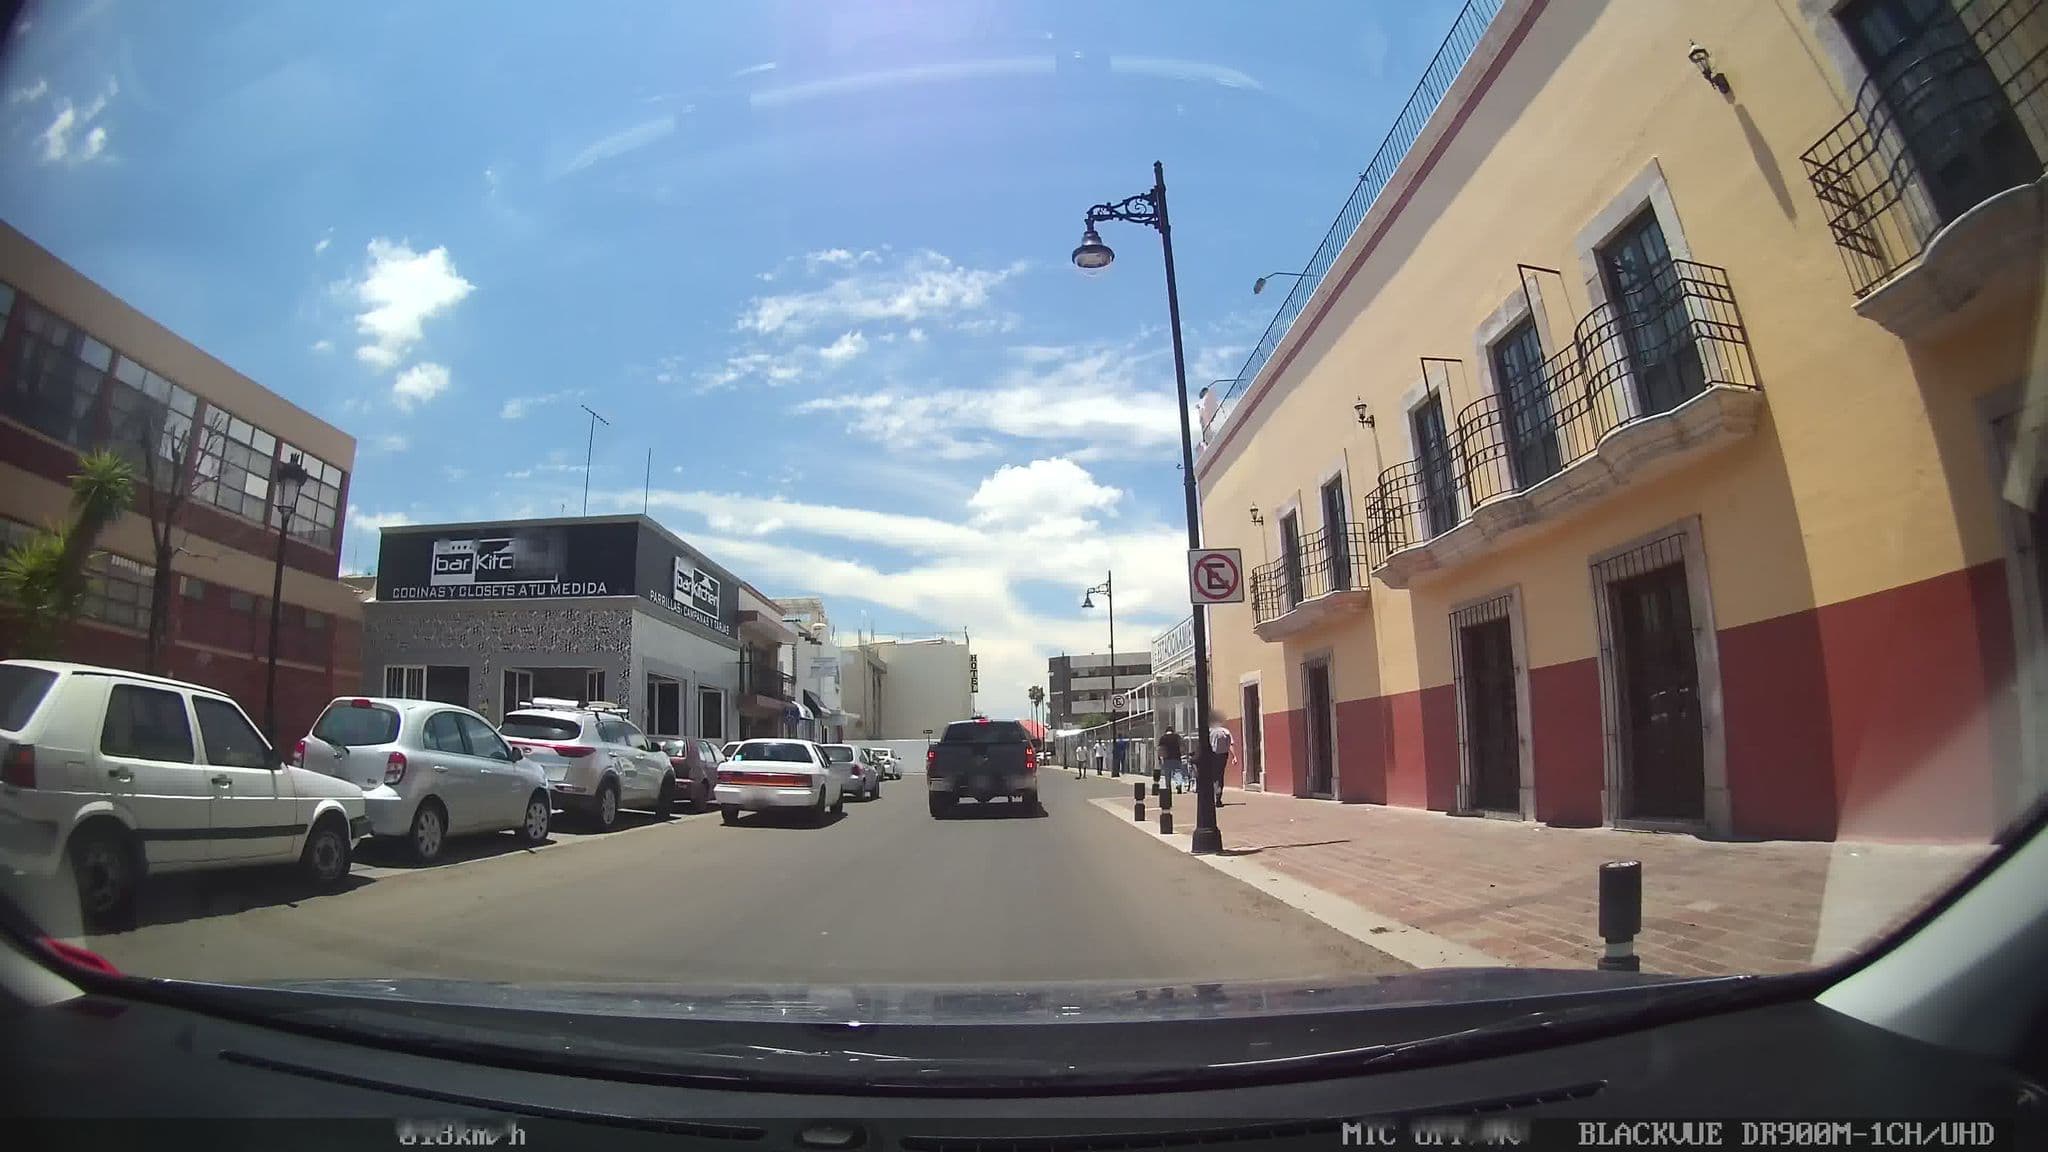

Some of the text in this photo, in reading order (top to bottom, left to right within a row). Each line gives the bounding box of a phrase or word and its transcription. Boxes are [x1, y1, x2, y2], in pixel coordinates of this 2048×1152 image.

[436, 556, 471, 571] bar
[392, 586, 446, 599] COCINAS
[448, 586, 456, 597] Y
[459, 584, 516, 597] CLOSETS
[550, 582, 608, 595] MEDIDA
[970, 654, 979, 693] HOTEL
